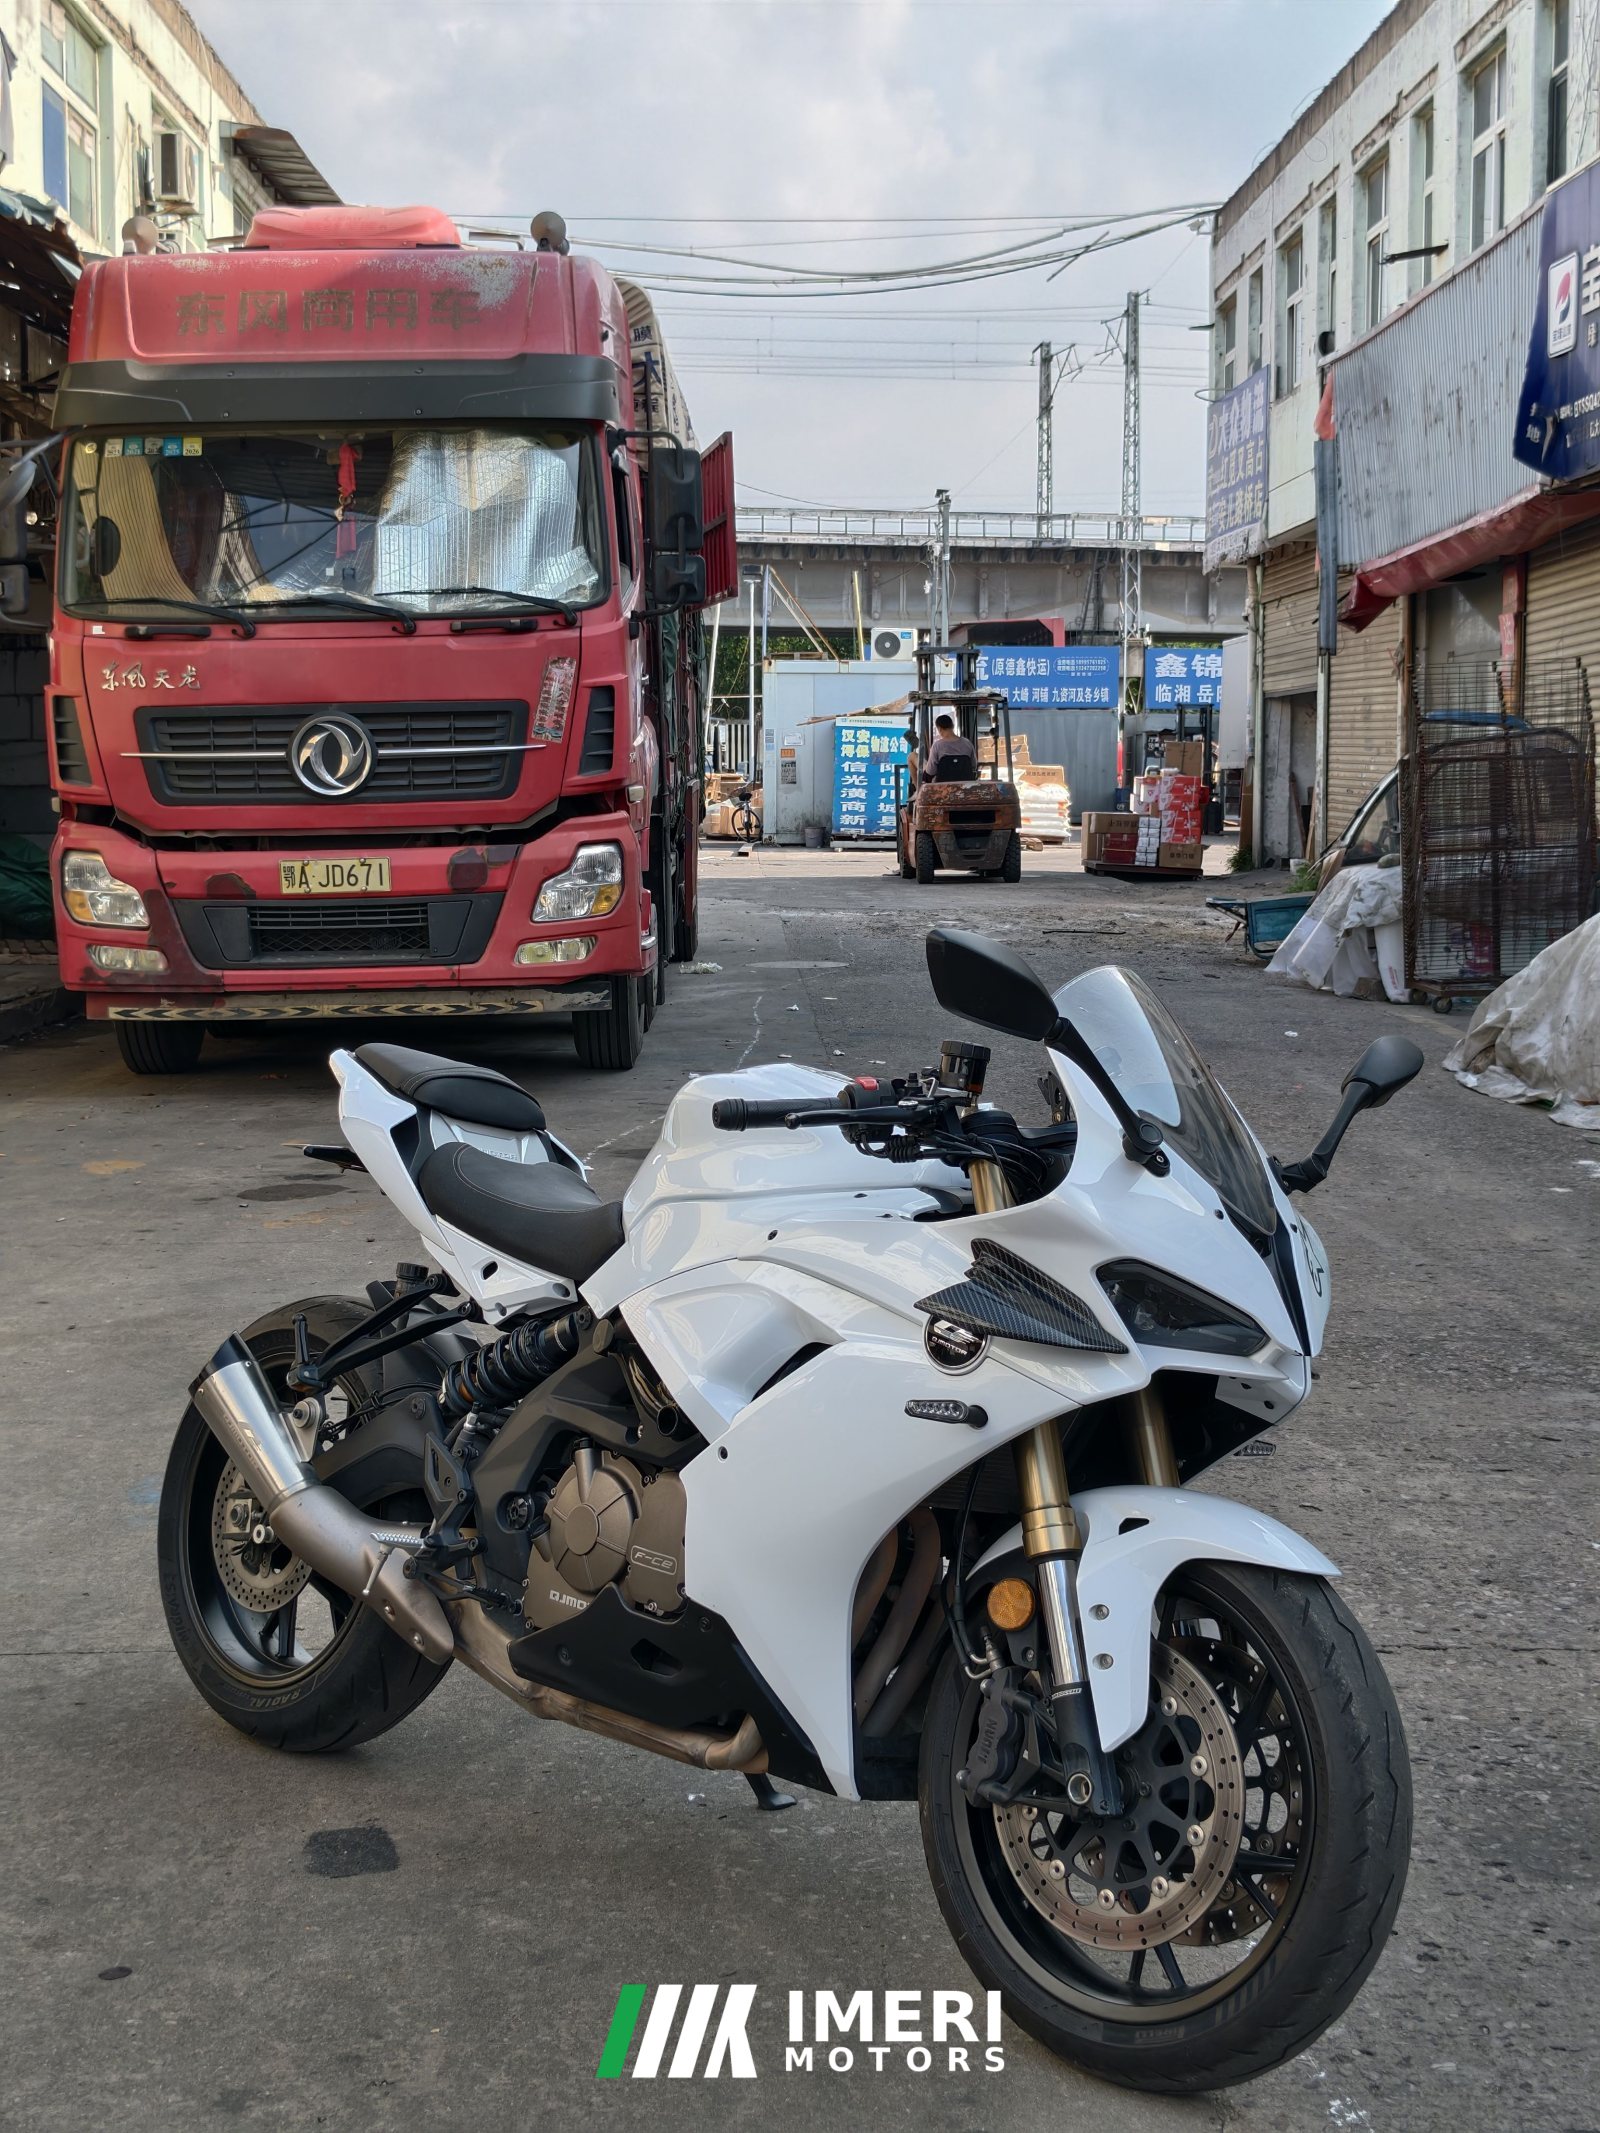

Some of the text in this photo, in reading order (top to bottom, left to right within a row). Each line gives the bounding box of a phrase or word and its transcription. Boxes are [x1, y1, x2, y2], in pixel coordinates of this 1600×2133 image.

[176, 288, 481, 336] 东风商用车
[992, 657, 1050, 676] (原德鑫快运)
[1155, 653, 1223, 679] 鑫锦
[1155, 684, 1191, 703] 临湘
[549, 1589, 591, 1610] QJMO
[252, 1689, 301, 1709] RADIAL
